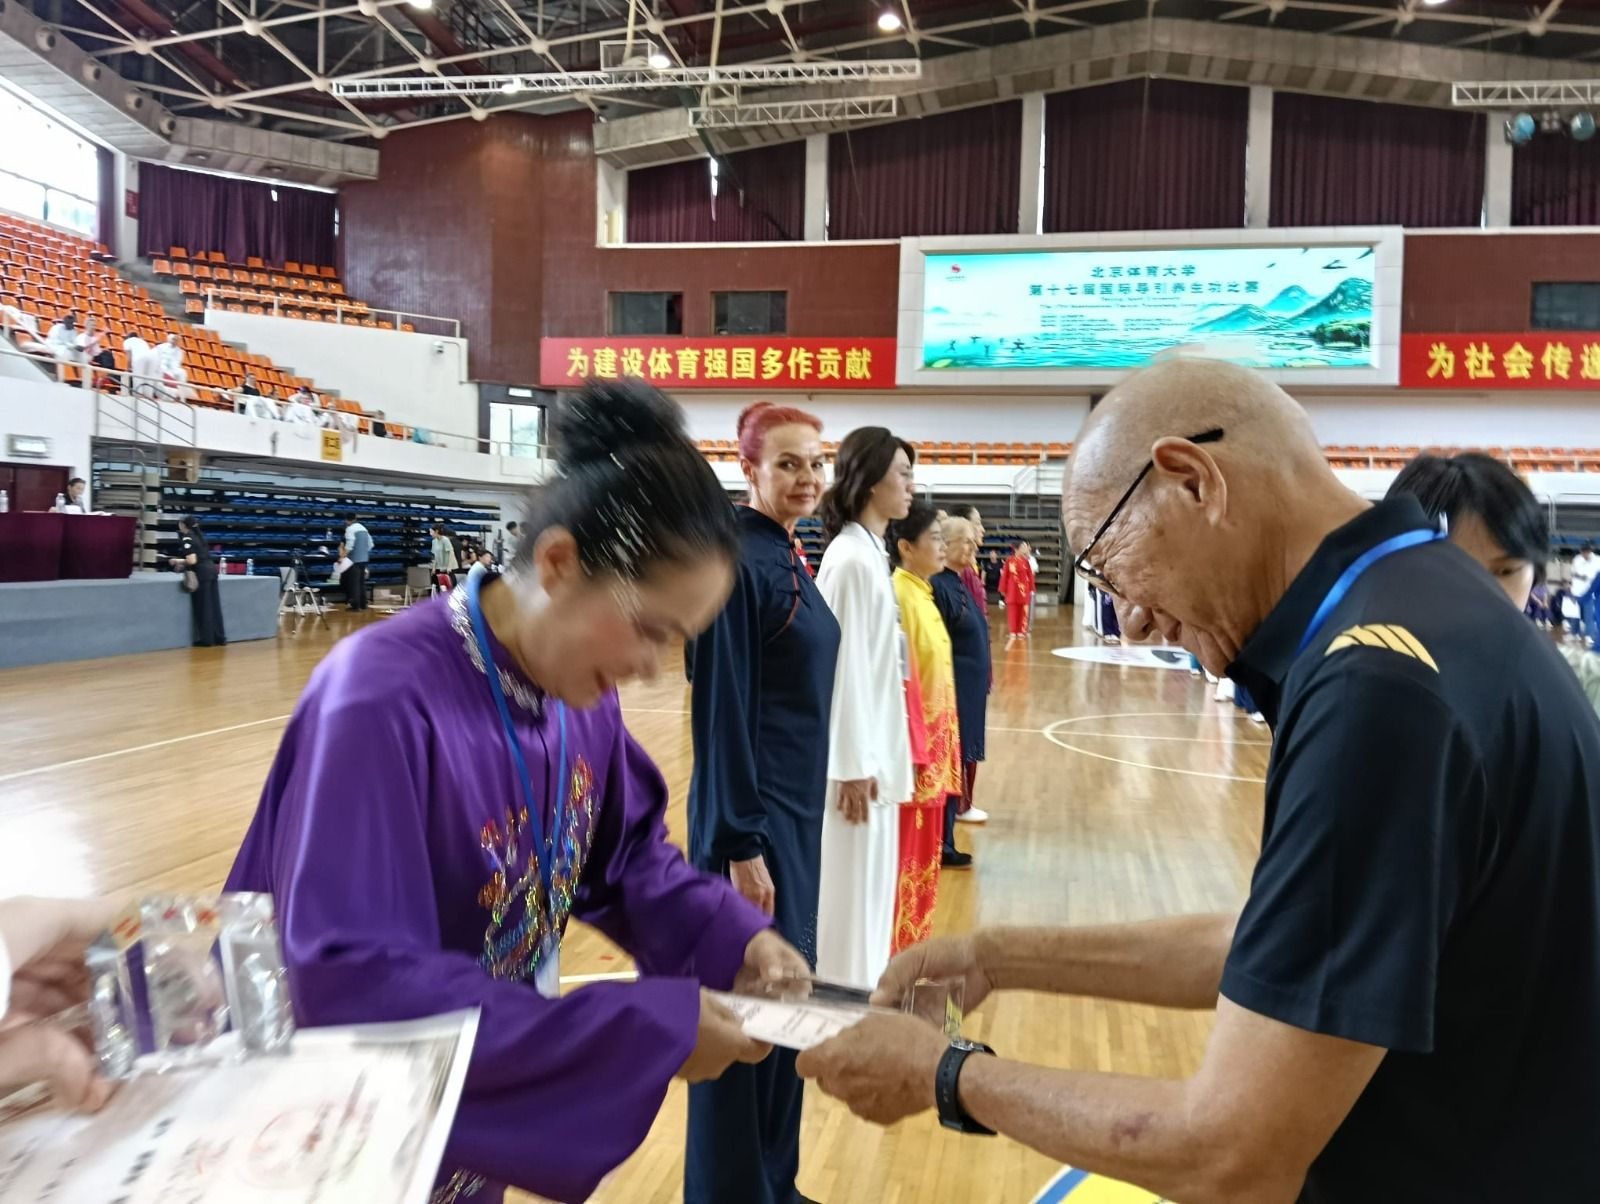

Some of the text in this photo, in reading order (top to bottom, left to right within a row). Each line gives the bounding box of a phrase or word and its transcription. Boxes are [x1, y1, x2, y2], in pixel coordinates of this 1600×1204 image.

[567, 346, 872, 380] 为建设体育强国多作贡献
